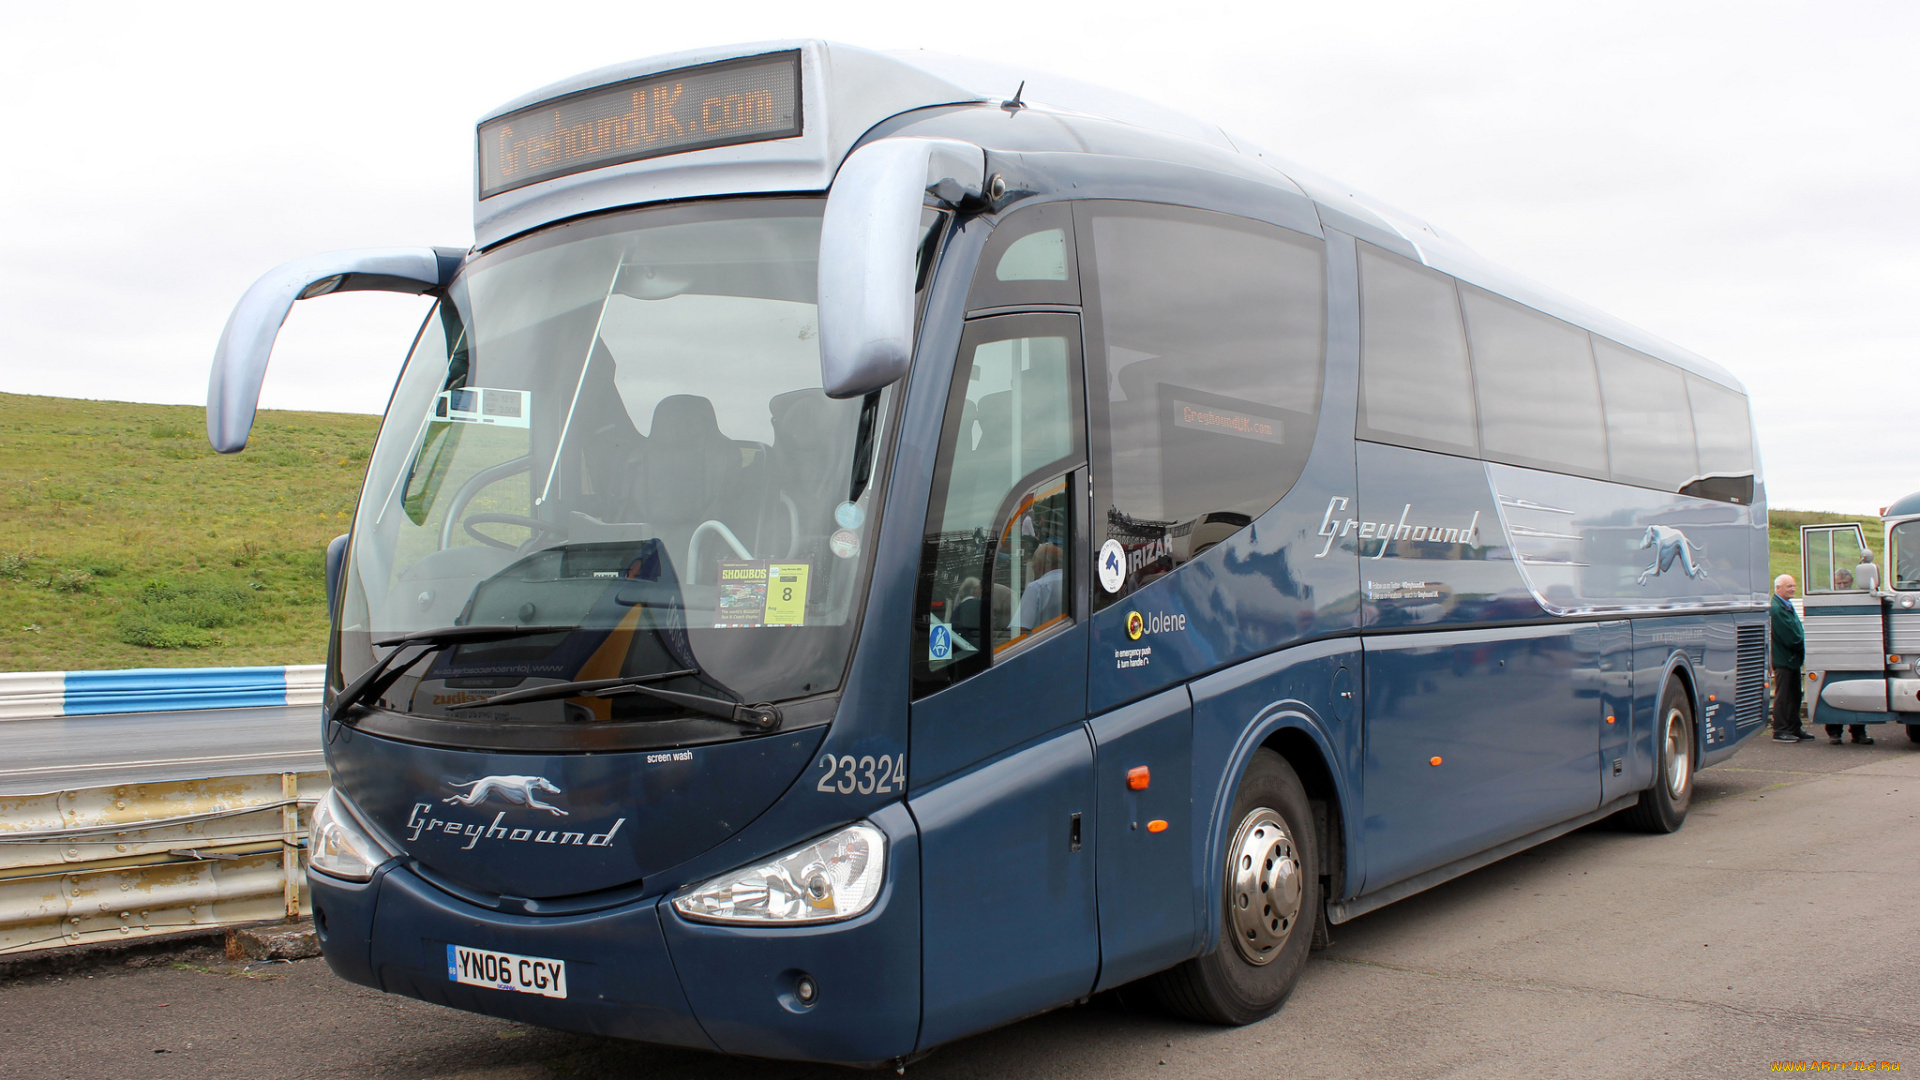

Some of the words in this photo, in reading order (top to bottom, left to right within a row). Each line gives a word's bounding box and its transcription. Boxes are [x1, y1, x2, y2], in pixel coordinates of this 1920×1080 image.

[499, 83, 773, 176] GreyhoundUK.com
[1314, 495, 1480, 561] Greyhound
[722, 569, 767, 579] SHOWBUS
[1128, 533, 1173, 575] IRIZAR
[782, 587, 793, 602] 8
[1144, 611, 1186, 635] Jolene
[646, 753, 672, 764] screen
[673, 750, 693, 761] wash
[816, 752, 906, 795] 23324
[406, 802, 626, 850] Greyhound
[459, 949, 512, 984] YN06
[518, 959, 561, 992] CGY
